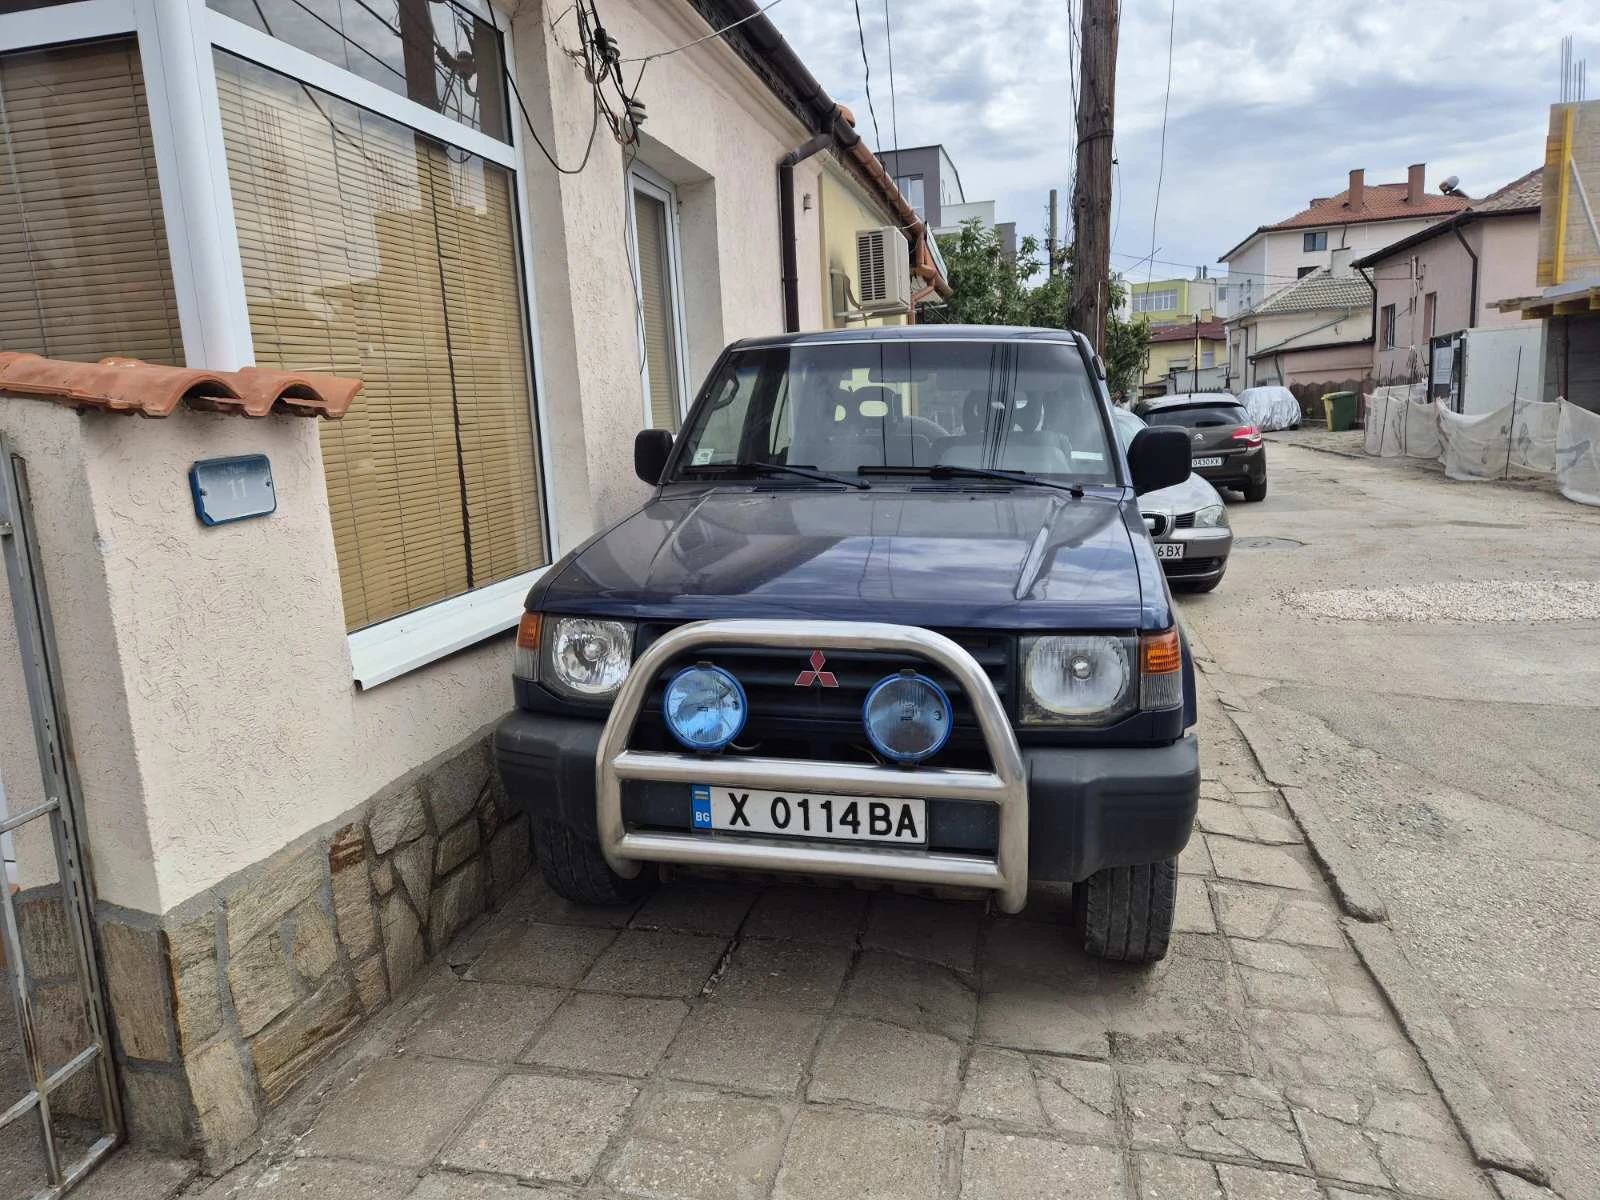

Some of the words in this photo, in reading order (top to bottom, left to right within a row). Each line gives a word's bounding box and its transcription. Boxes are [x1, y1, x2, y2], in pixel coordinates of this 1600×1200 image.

[227, 478, 248, 501] 11
[695, 811, 710, 823] BG
[728, 792, 751, 827] X
